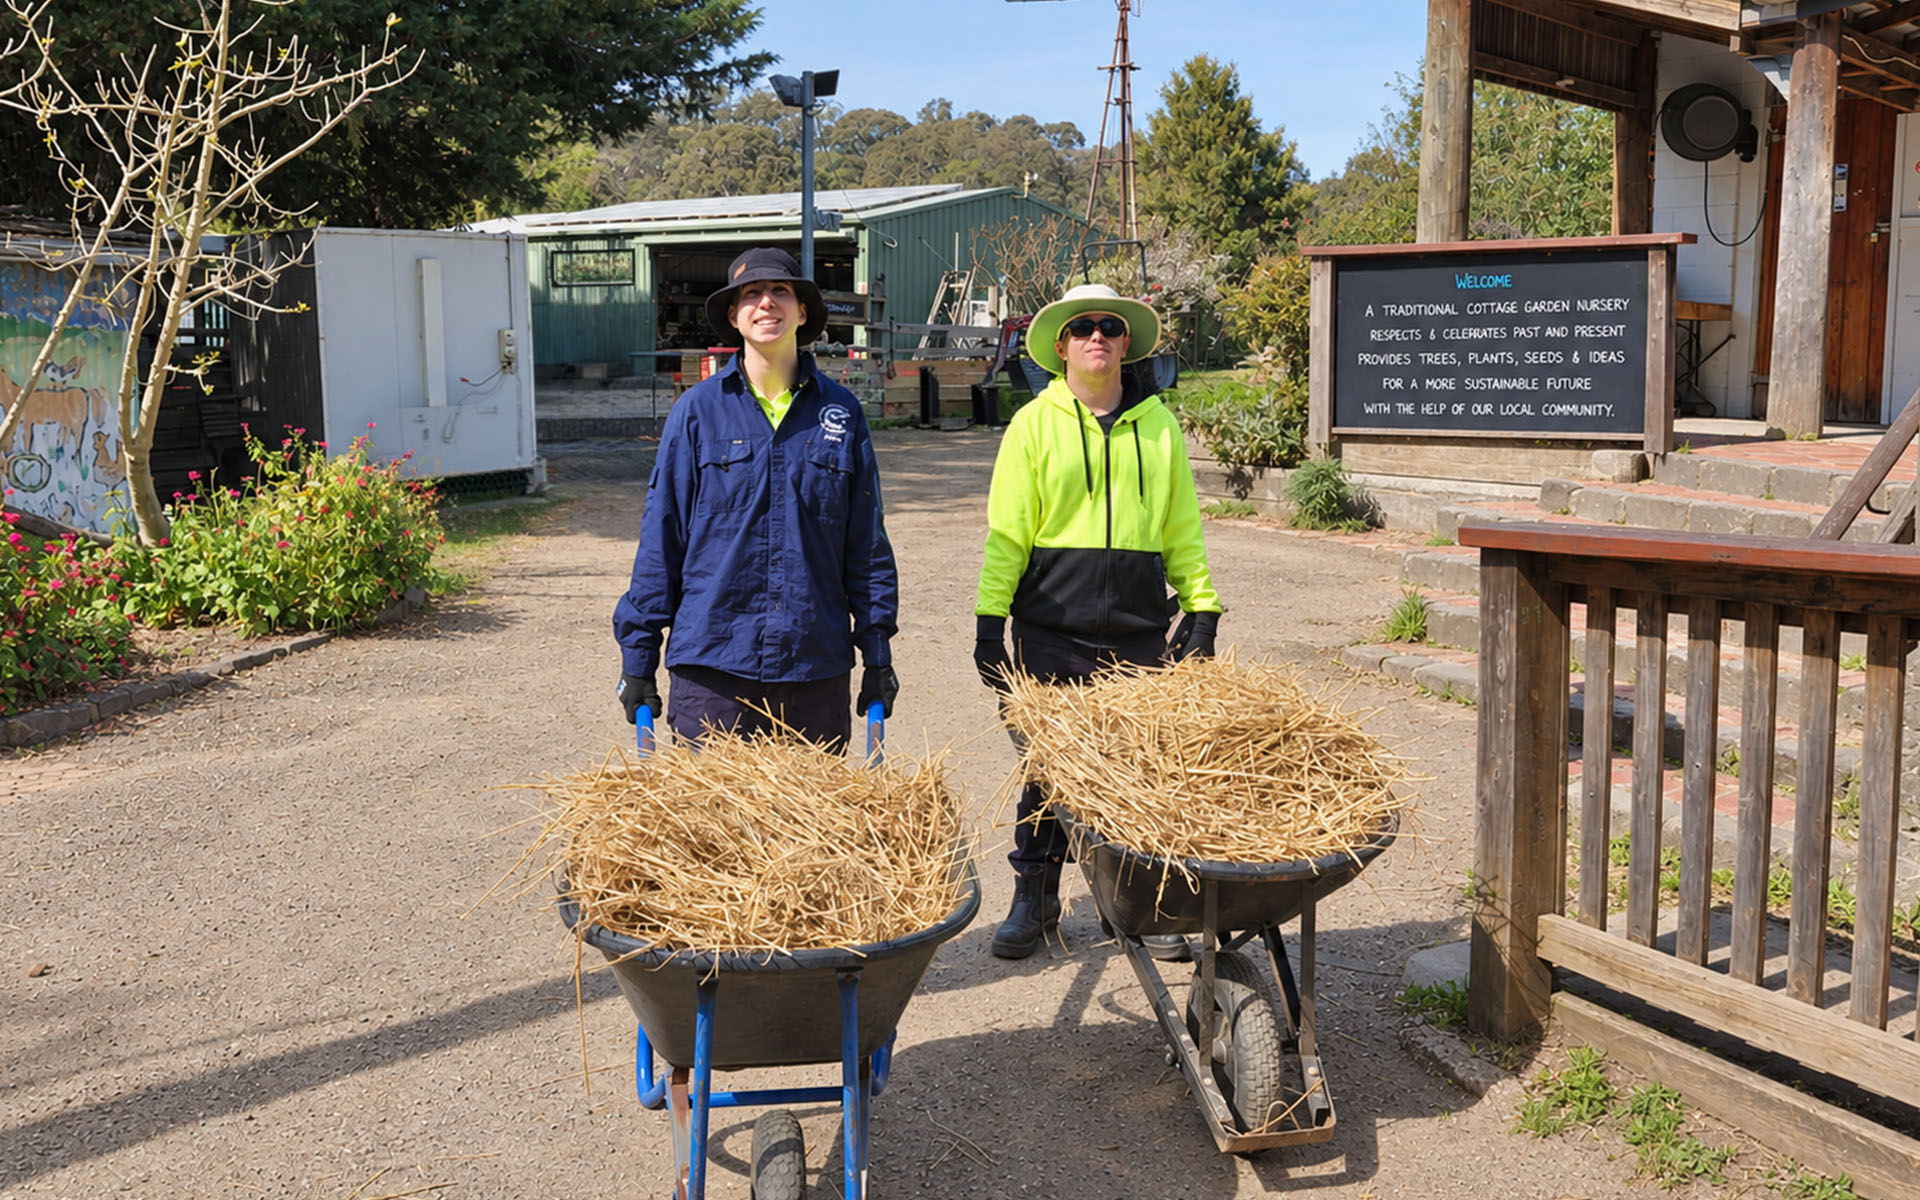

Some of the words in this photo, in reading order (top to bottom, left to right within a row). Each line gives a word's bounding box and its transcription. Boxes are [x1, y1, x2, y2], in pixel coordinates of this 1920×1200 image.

[1365, 305, 1374, 317] A
[1382, 304, 1458, 316] TRADITIONAL
[1467, 301, 1518, 314] COTTAGE
[1524, 300, 1570, 313] GARDEN
[1577, 298, 1629, 311] NURSERY
[1370, 329, 1422, 341] RESPECTS
[1429, 328, 1436, 340] &
[1513, 326, 1541, 338] PAST
[1545, 326, 1568, 337] AND
[1575, 325, 1626, 337] PRESENT
[1358, 353, 1411, 365] PROVIDES
[1418, 353, 1461, 367] TREES,
[1469, 352, 1518, 366] PLANTS,
[1524, 351, 1563, 363] SEEDS
[1572, 350, 1580, 364] &
[1589, 351, 1625, 363] IDEAS
[1383, 378, 1404, 389] FOR
[1410, 378, 1418, 389] A
[1426, 378, 1456, 390] MORE
[1465, 378, 1539, 390] SUSTAINABLE
[1547, 377, 1591, 390] FUTURE
[1364, 403, 1391, 415] WITH
[1395, 403, 1415, 415] THE
[1421, 403, 1446, 415] HELP
[1452, 403, 1465, 415] OF
[1472, 403, 1494, 415] OUR
[1500, 403, 1535, 415] LOCAL
[1542, 404, 1614, 417] COMMUNITY.
